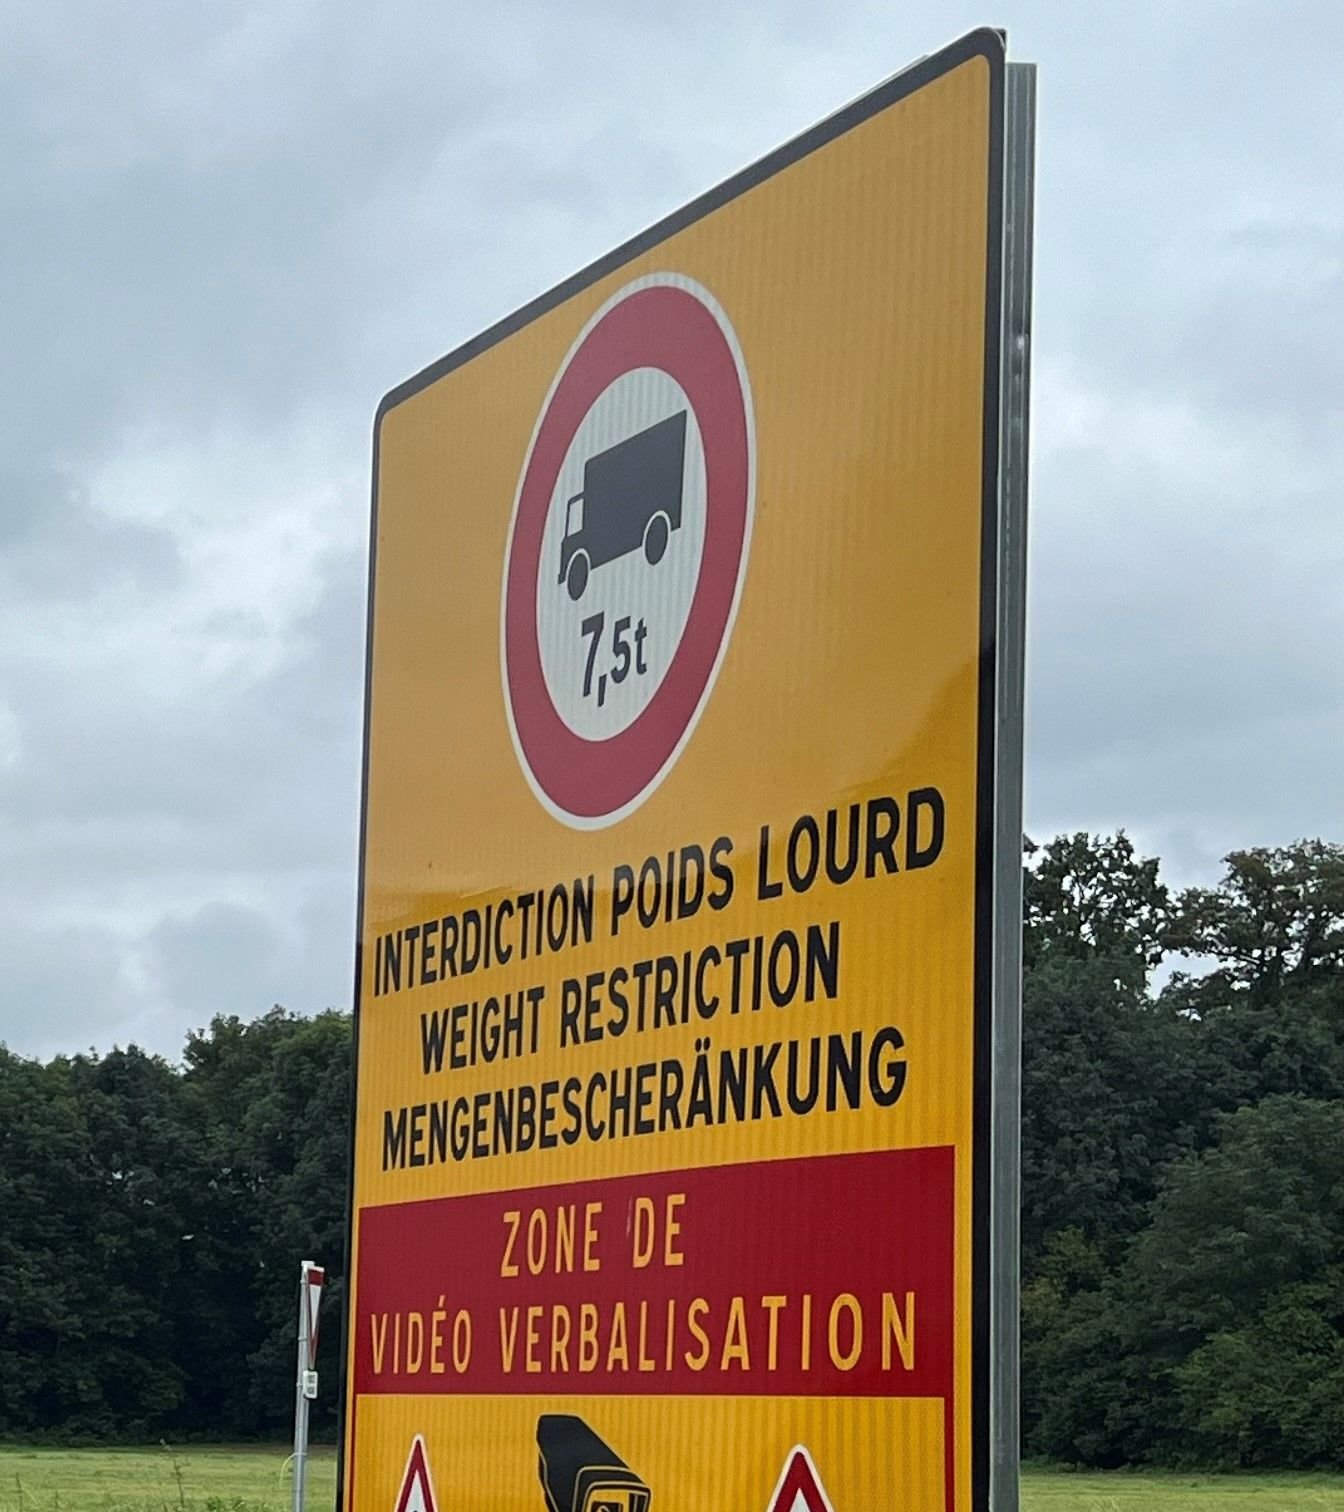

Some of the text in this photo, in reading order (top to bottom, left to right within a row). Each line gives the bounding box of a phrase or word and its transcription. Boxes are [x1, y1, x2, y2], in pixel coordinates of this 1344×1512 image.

[580, 610, 647, 709] 7,5t
[374, 786, 944, 997] INTERDICTION POIDS LOURD
[420, 921, 840, 1075] WEIGHT RESTRICTION
[382, 1026, 907, 1172] MENGENBESCHERÄNKUNG
[500, 1192, 687, 1278] ZONE DE
[370, 1291, 915, 1374] VIDÉO VERBALISATION
